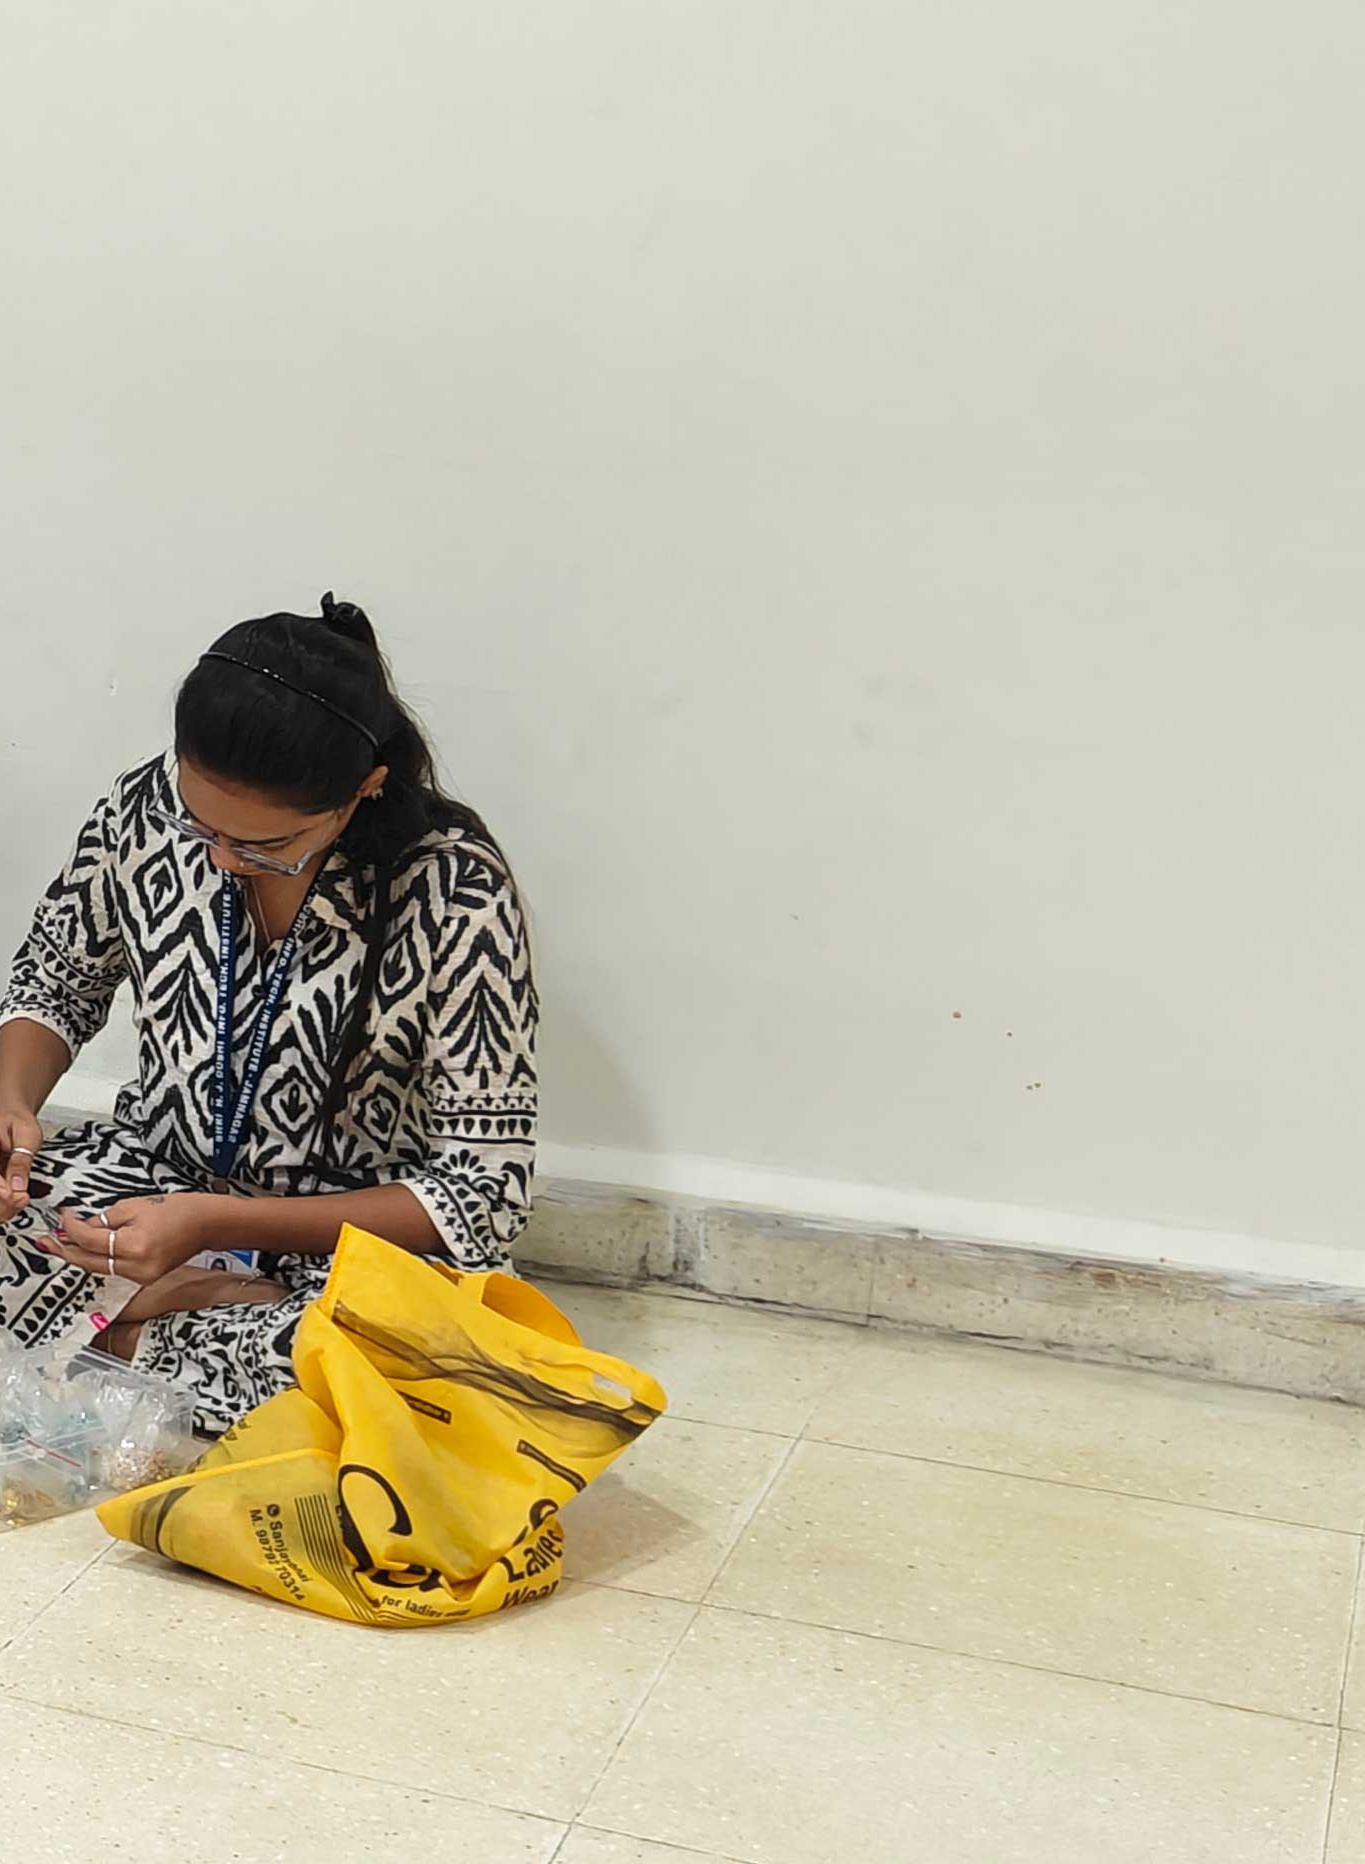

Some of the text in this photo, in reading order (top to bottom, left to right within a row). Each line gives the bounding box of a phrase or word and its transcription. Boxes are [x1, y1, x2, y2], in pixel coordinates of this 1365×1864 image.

[215, 1040, 226, 1079] DOSHI
[221, 893, 232, 960] INSTITUTE
[265, 972, 283, 1006] TECH.
[247, 1008, 272, 1073] INSTITUTE
[228, 1079, 254, 1143] JAMNAGAR
[381, 1594, 403, 1607] for
